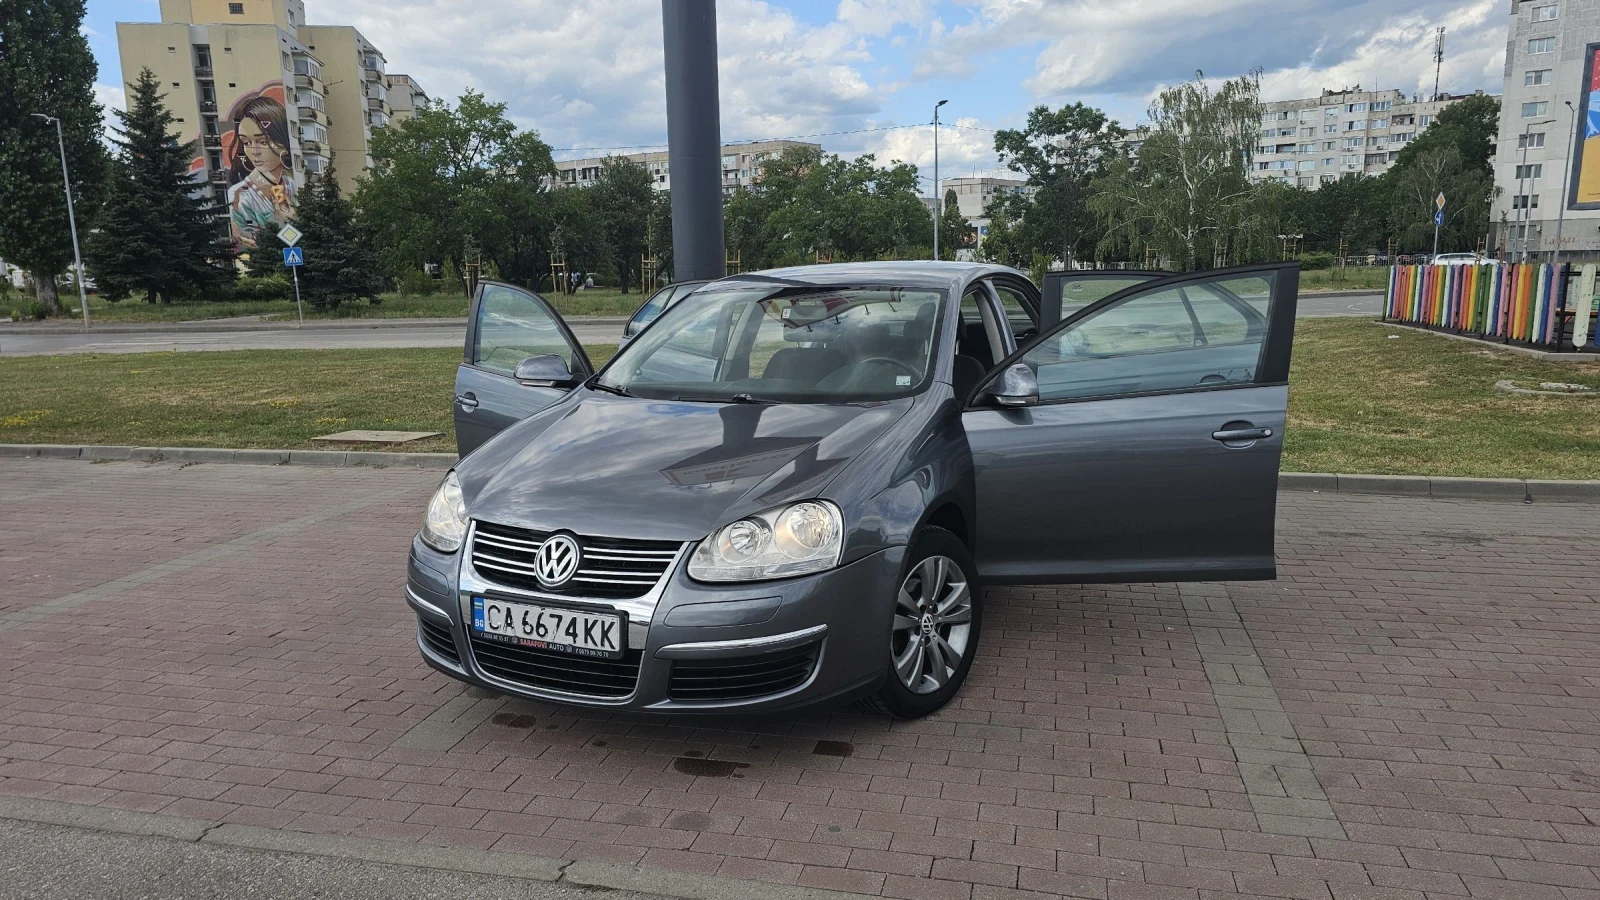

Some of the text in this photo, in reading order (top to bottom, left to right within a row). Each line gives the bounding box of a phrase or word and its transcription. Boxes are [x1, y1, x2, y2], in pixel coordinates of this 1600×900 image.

[535, 535, 579, 586] VW
[475, 618, 484, 628] BG
[488, 604, 616, 650] CA 6674 KK
[549, 643, 564, 652] AUTO
